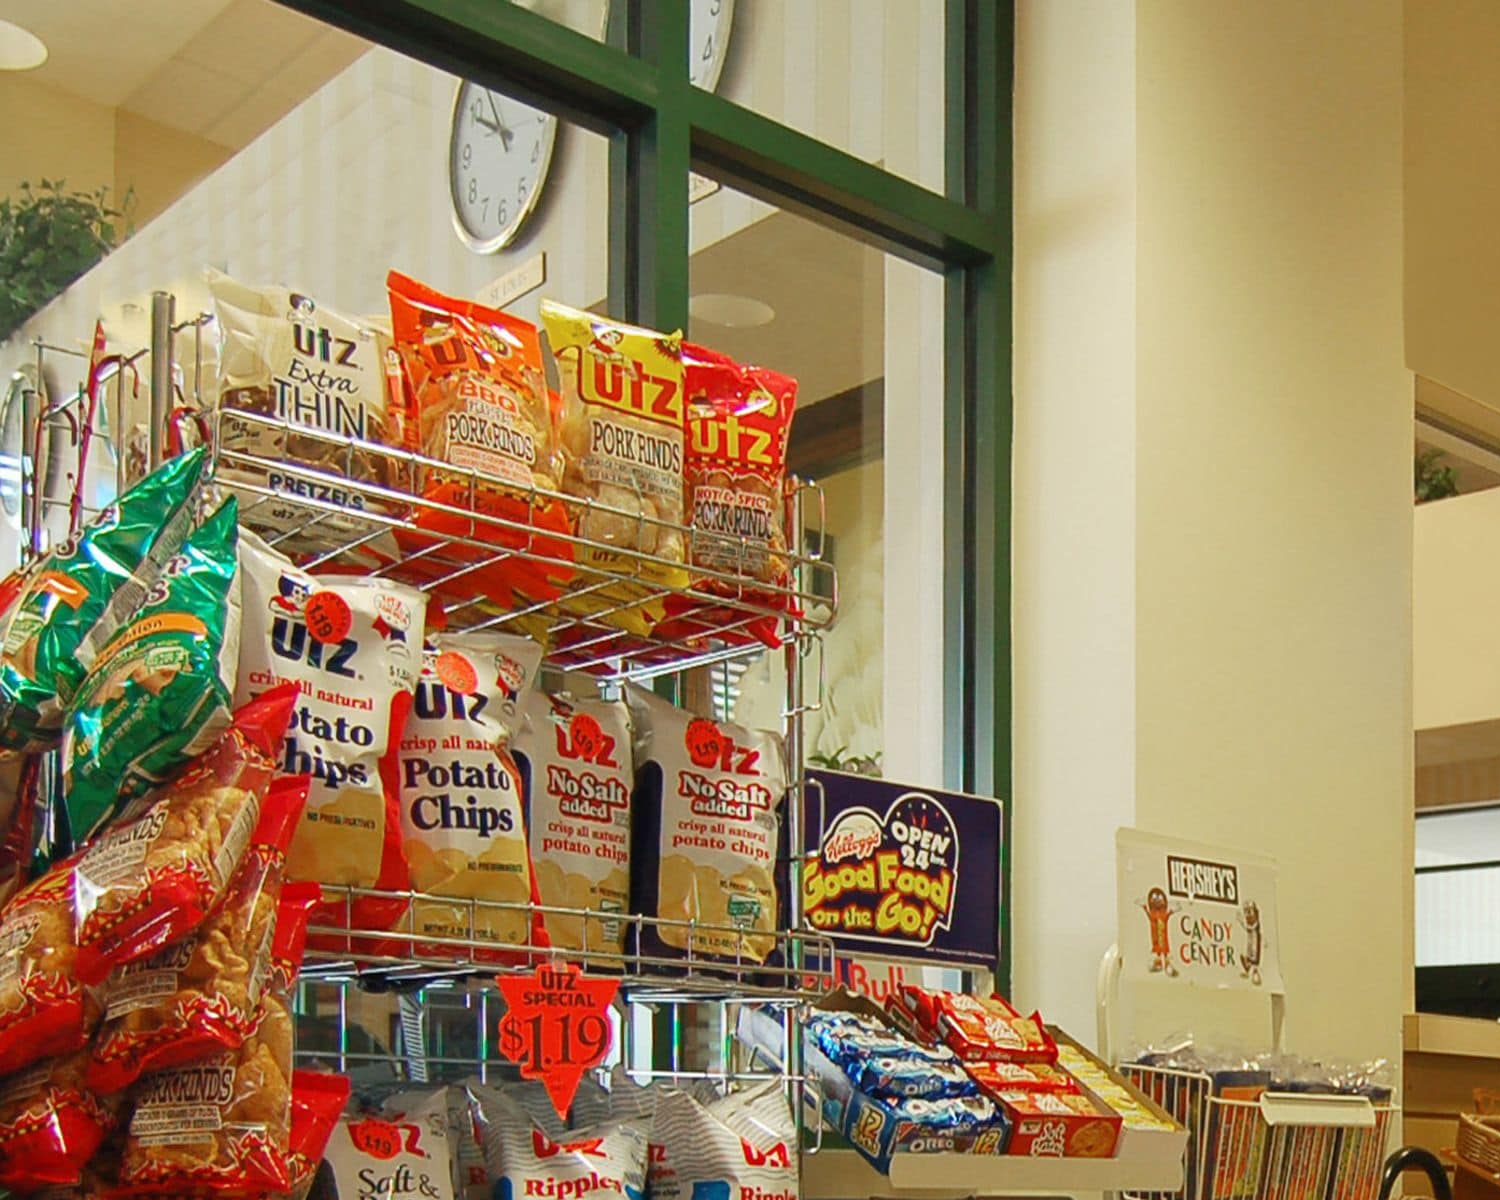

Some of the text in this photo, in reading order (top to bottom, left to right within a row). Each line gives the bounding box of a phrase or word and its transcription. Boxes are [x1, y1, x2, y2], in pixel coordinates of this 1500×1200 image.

[288, 359, 359, 395] Extra
[274, 378, 366, 440] THIN
[458, 380, 518, 413] BBQ
[449, 414, 535, 464] PORK RINDS
[592, 420, 681, 476] PORK RINDS
[696, 487, 719, 502] HOT
[316, 688, 374, 712] natural
[286, 704, 374, 748] otato
[400, 735, 461, 752] crisp all
[275, 737, 369, 789] hips
[402, 757, 512, 793] Potato
[580, 775, 628, 807] Salt
[681, 773, 770, 808] No Salt
[409, 796, 515, 838] Chips
[560, 801, 609, 820] added
[693, 801, 748, 818] added
[548, 820, 574, 838] crisp
[577, 823, 590, 838] all
[678, 818, 767, 845] crisp all natural
[890, 820, 952, 856] OPEN
[542, 836, 628, 864] potato chips
[672, 832, 771, 862] potato chips
[823, 828, 884, 865] Kellogg's
[901, 843, 931, 870] 24
[802, 852, 951, 913] Good Food
[1169, 859, 1237, 901] HERSHEY'S
[812, 891, 936, 939] on the Go!
[1180, 915, 1233, 942] CANDY
[1180, 942, 1236, 968] CENTER
[540, 971, 578, 991] UTZ
[523, 991, 596, 1008] SPECIAL
[501, 1012, 608, 1074] $1.19
[357, 1164, 441, 1199] Salt &
